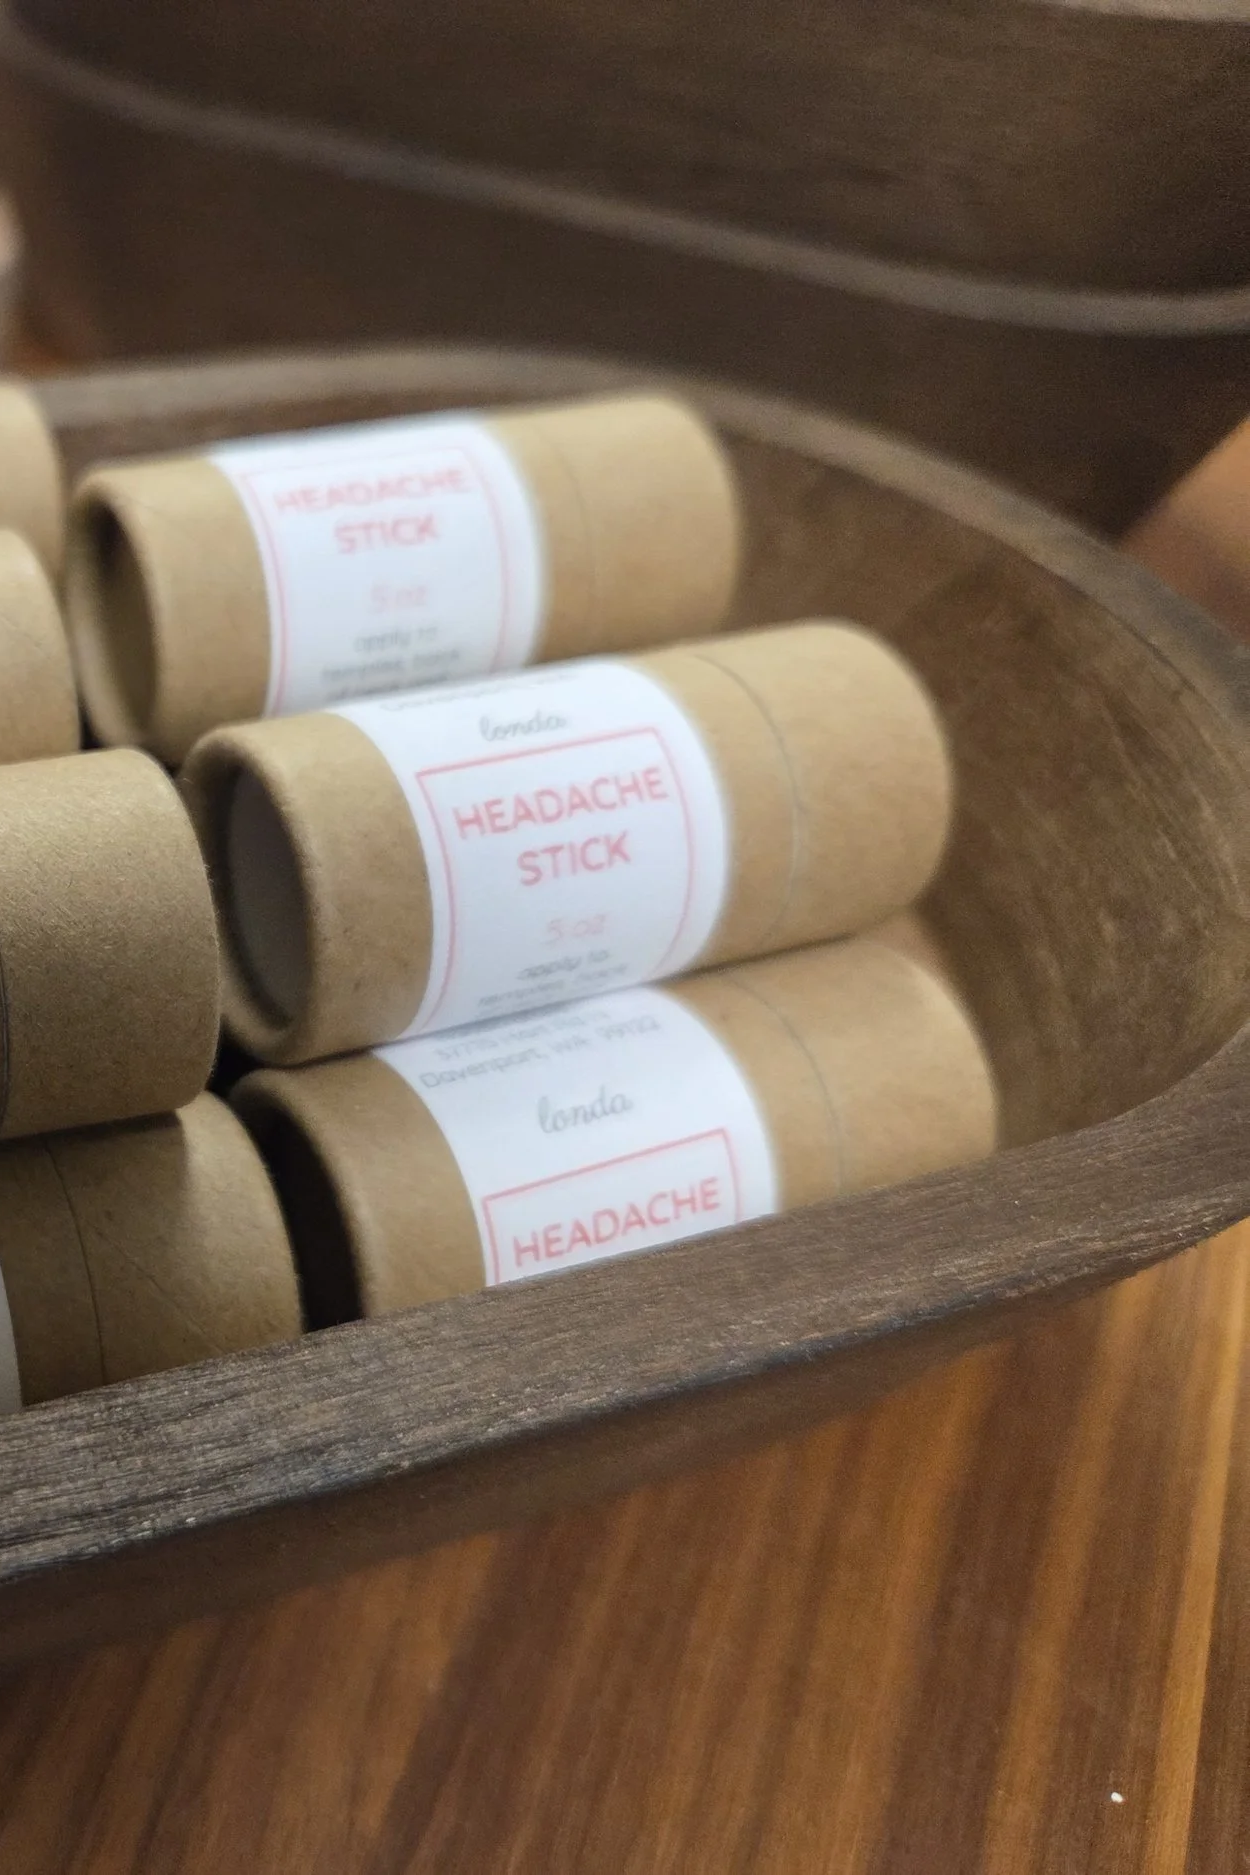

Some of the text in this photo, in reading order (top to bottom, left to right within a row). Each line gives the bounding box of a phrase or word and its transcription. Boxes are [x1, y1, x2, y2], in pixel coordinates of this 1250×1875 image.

[273, 466, 467, 514] HEADACHE
[333, 512, 440, 556] STICK
[452, 766, 669, 841] HEADACHE
[516, 830, 632, 887] STICK
[536, 1085, 634, 1135] londa
[512, 1176, 721, 1268] HEADACHE
